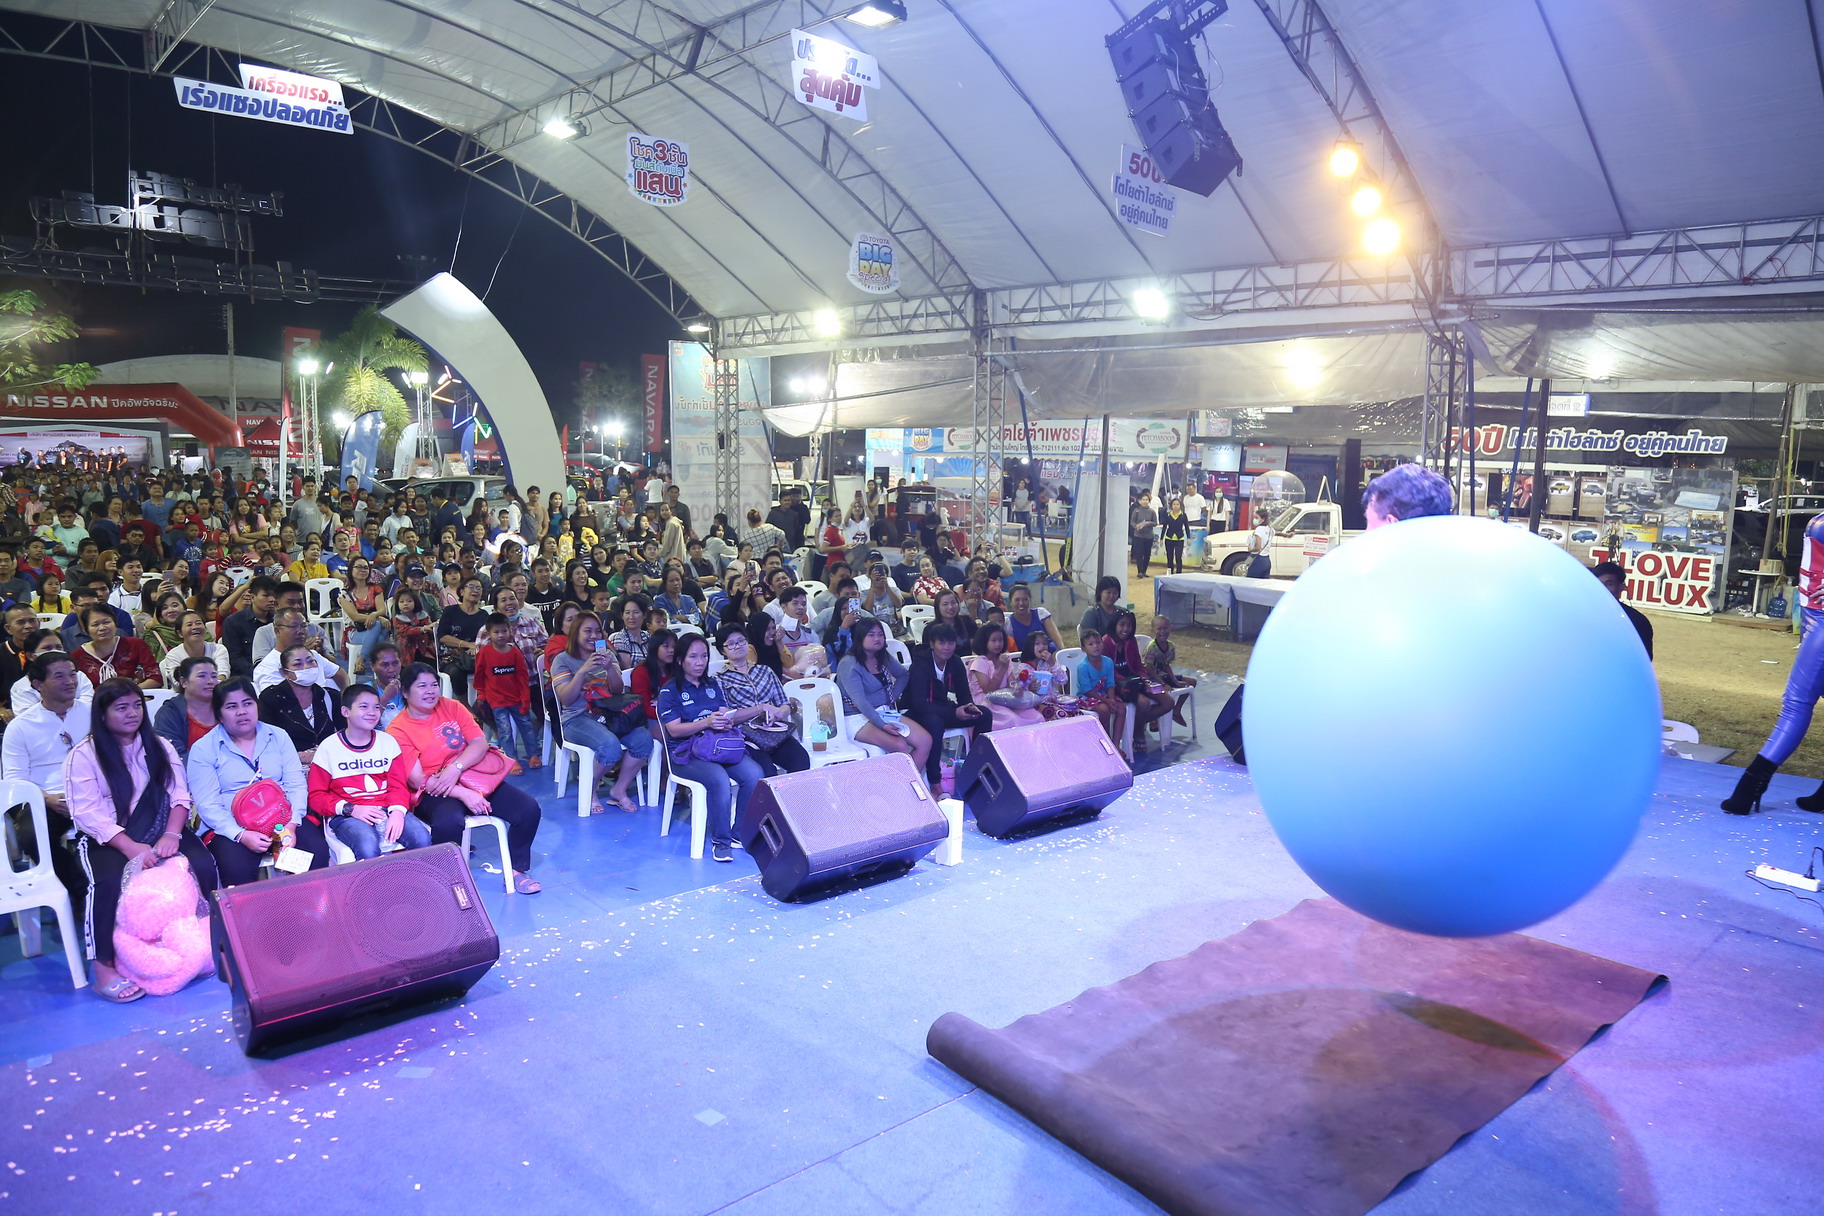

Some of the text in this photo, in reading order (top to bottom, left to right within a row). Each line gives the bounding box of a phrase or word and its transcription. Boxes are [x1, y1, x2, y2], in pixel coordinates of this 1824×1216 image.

[799, 67, 863, 112] สุดคุ้ม
[181, 82, 350, 132] เร่งแซงปลอดภัย
[636, 170, 682, 196] แสน
[859, 241, 893, 264] BIG
[869, 236, 890, 245] TOYOTA
[859, 260, 892, 278] DAY
[6, 394, 108, 409] NISSAN
[646, 364, 660, 451] NAVARA
[1625, 430, 1727, 456] อยู่คู่คนไทย
[1619, 551, 1712, 582] LOVE
[1624, 578, 1709, 608] HILUX
[337, 757, 389, 771] adidas
